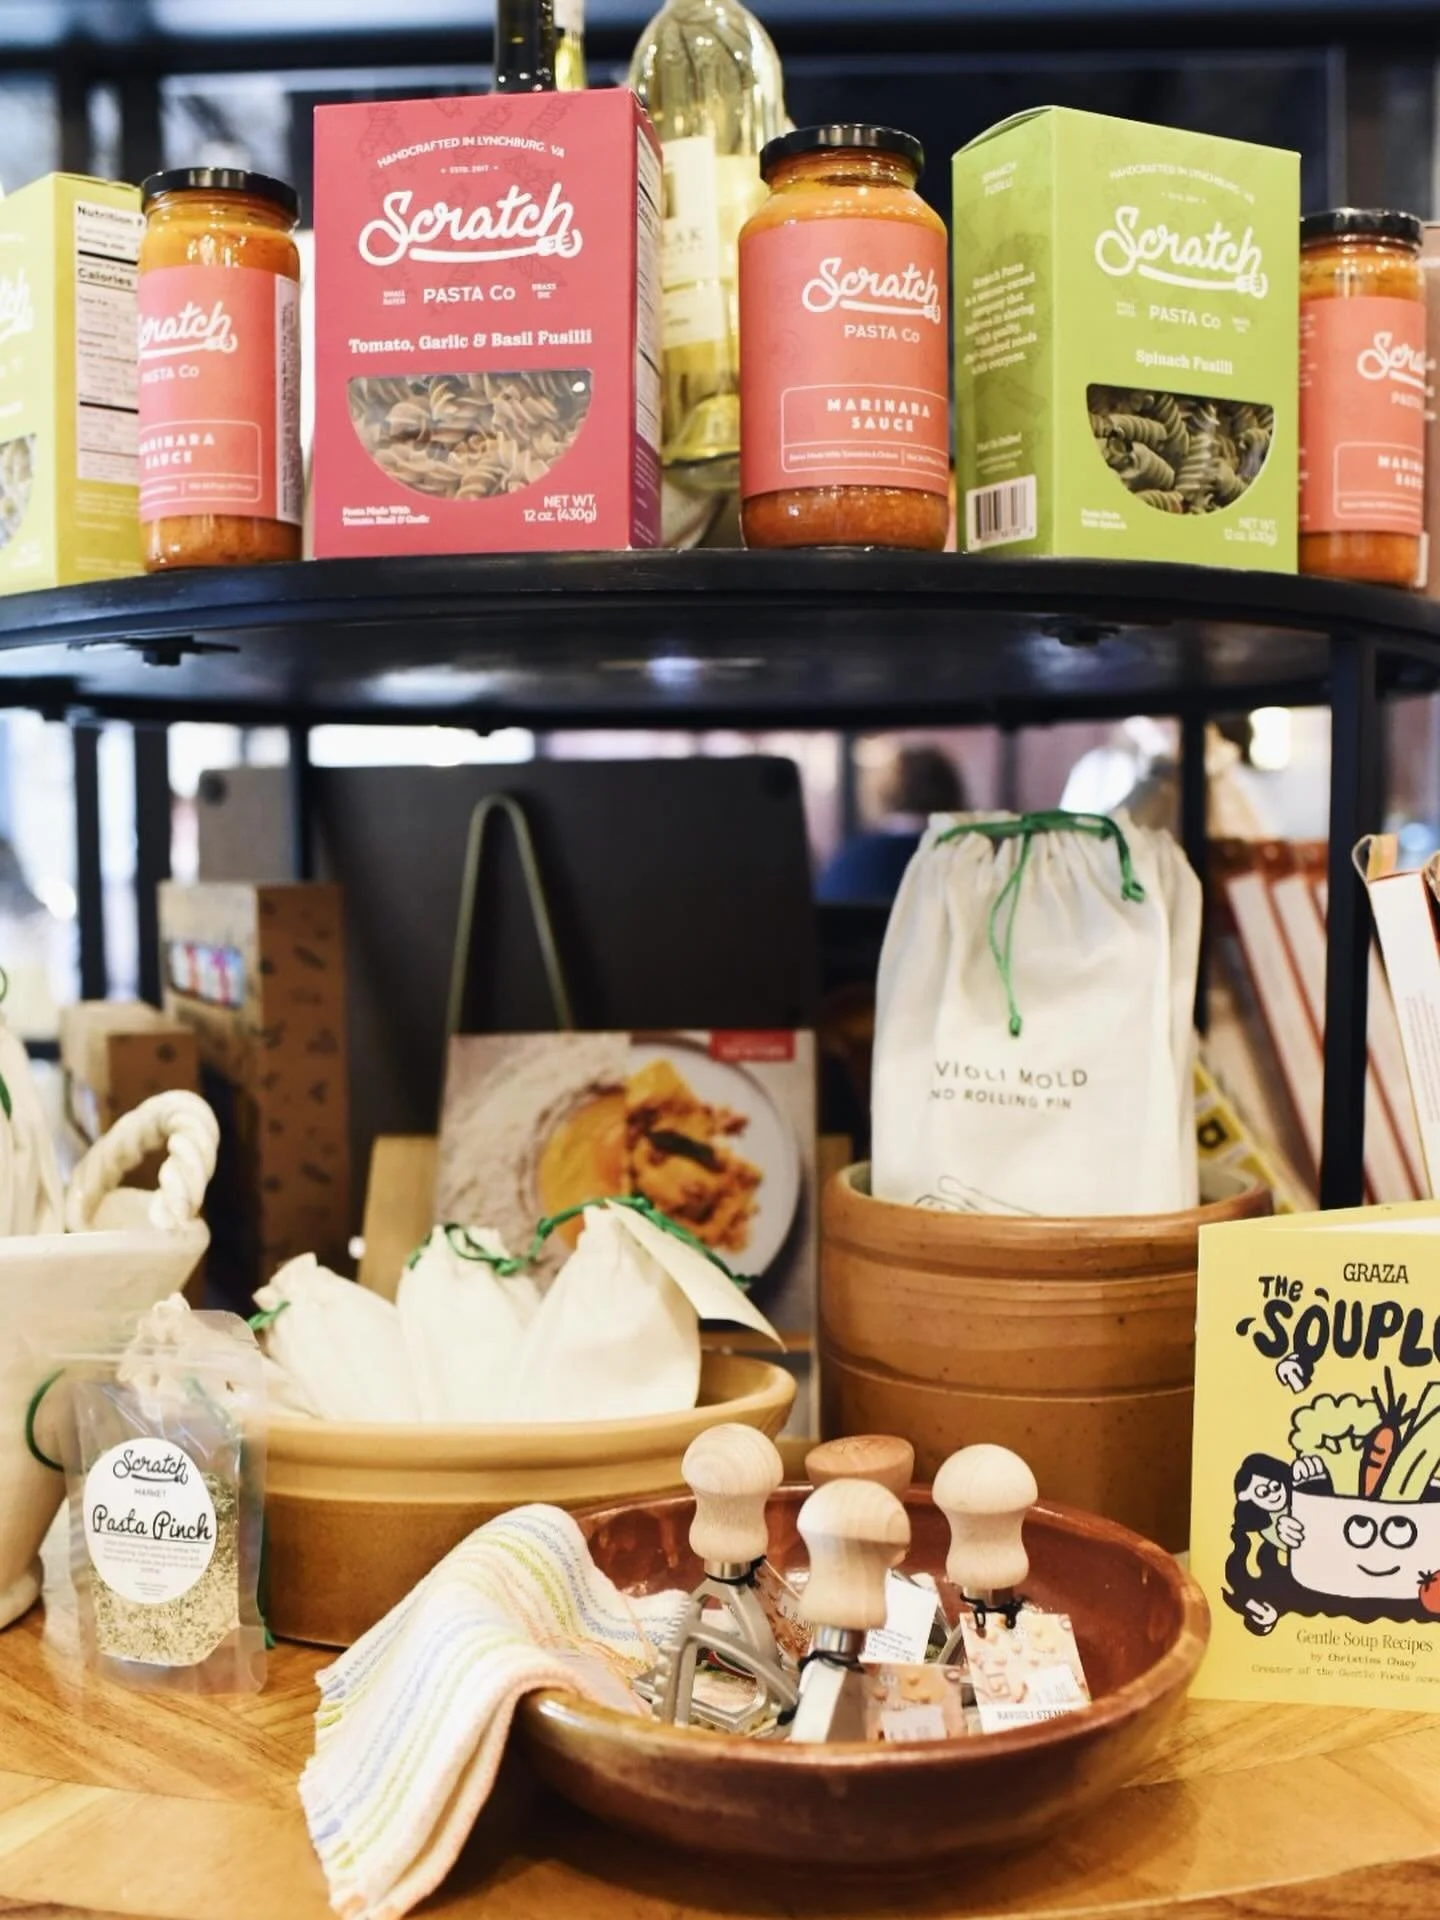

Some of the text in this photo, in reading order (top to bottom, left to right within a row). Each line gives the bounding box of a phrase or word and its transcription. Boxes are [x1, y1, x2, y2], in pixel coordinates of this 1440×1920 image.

[377, 137, 460, 168] HANDCRAFTED
[462, 136, 475, 147] IN
[552, 145, 565, 158] VA
[358, 182, 583, 266] Scratch
[1094, 205, 1268, 298] Scratch
[78, 266, 132, 287] Calories
[423, 285, 484, 304] PASTA
[490, 284, 516, 301] Co
[802, 257, 941, 325] Scratch
[1150, 304, 1197, 327] PASTA
[1201, 312, 1222, 330] Co
[349, 329, 593, 354] Tomato, Garlic & Basil Fusilli
[844, 324, 921, 344] PASTA Co
[1135, 350, 1233, 375] Spinach Fusilli
[827, 398, 930, 418] MARINARA
[852, 416, 913, 432] SAUCE
[544, 495, 568, 508] NET
[523, 509, 535, 521] 12
[557, 506, 597, 523] (430g)
[935, 1061, 1088, 1090] VIOLI MOLD
[930, 1088, 1072, 1110] ND ROLLING PIN
[1343, 1263, 1409, 1284] GRAZA
[1253, 1299, 1440, 1368] SOUPL
[113, 1449, 189, 1486] Scratch
[134, 1488, 167, 1499] MARKET
[92, 1504, 212, 1540] Pasta Pinch
[1296, 1629, 1433, 1655] Gentle Soup Recipes
[1311, 1653, 1322, 1663] by
[1328, 1653, 1381, 1665] Christina
[1251, 1664, 1440, 1684] Creator of the Gentle Foods news
